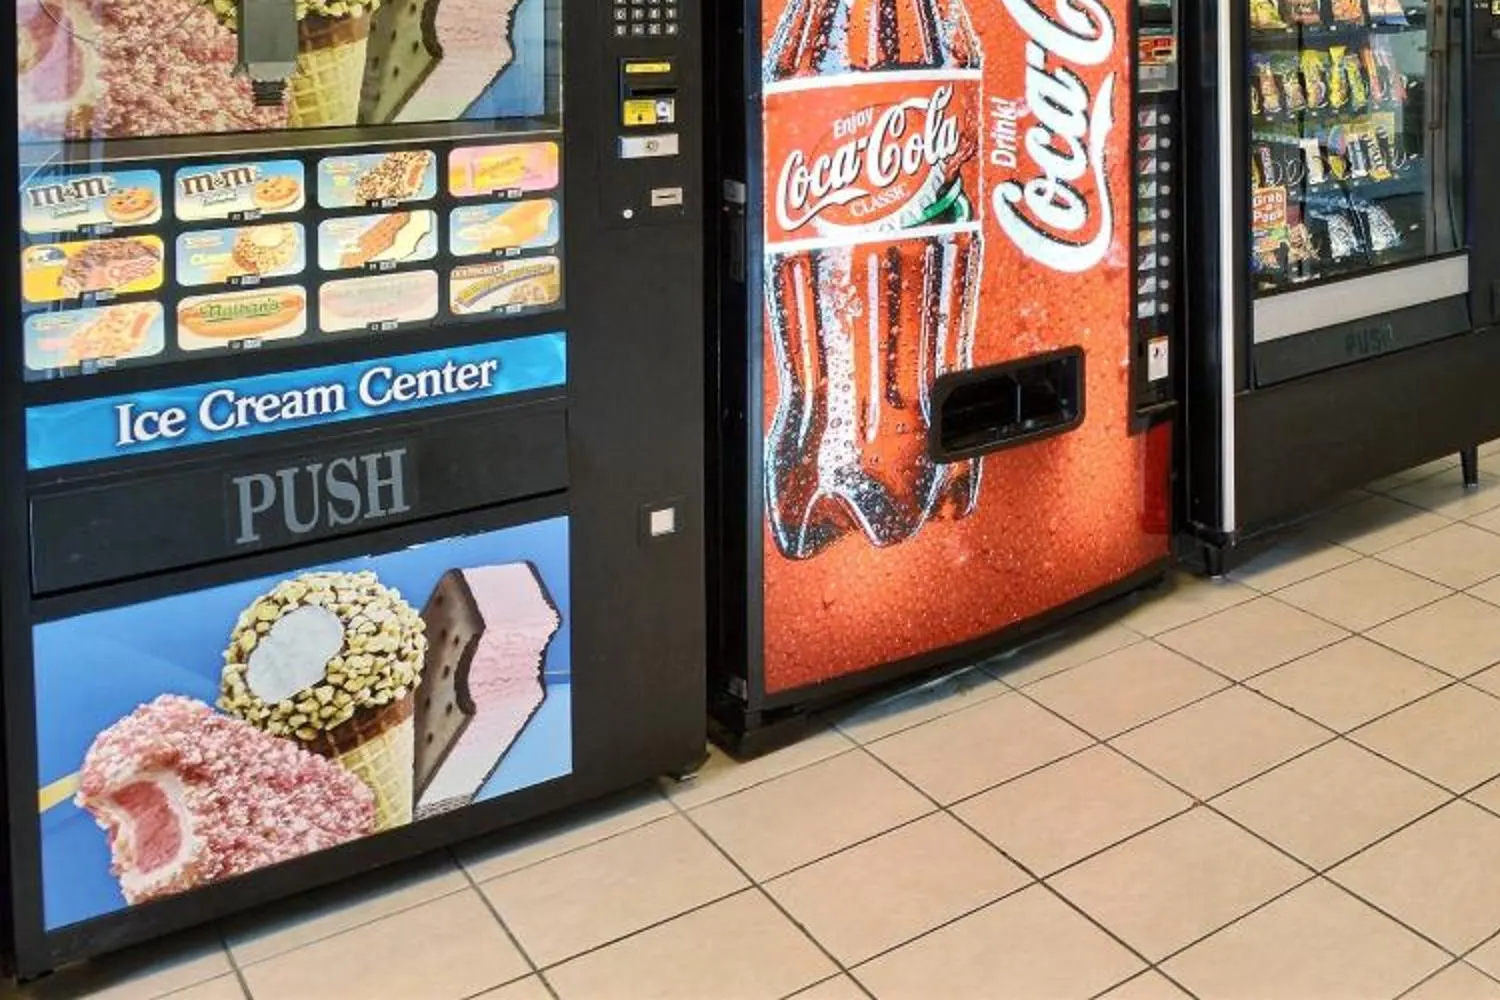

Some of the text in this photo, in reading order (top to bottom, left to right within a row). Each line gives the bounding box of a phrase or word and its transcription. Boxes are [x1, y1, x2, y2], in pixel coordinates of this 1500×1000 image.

[776, 83, 960, 232] Coca-Cola
[833, 107, 874, 139] Enjoy
[990, 97, 1017, 169] Drink!
[850, 182, 910, 217] CLASSIC
[115, 358, 497, 448] Ice Cream Center
[233, 449, 410, 545] PUSH
